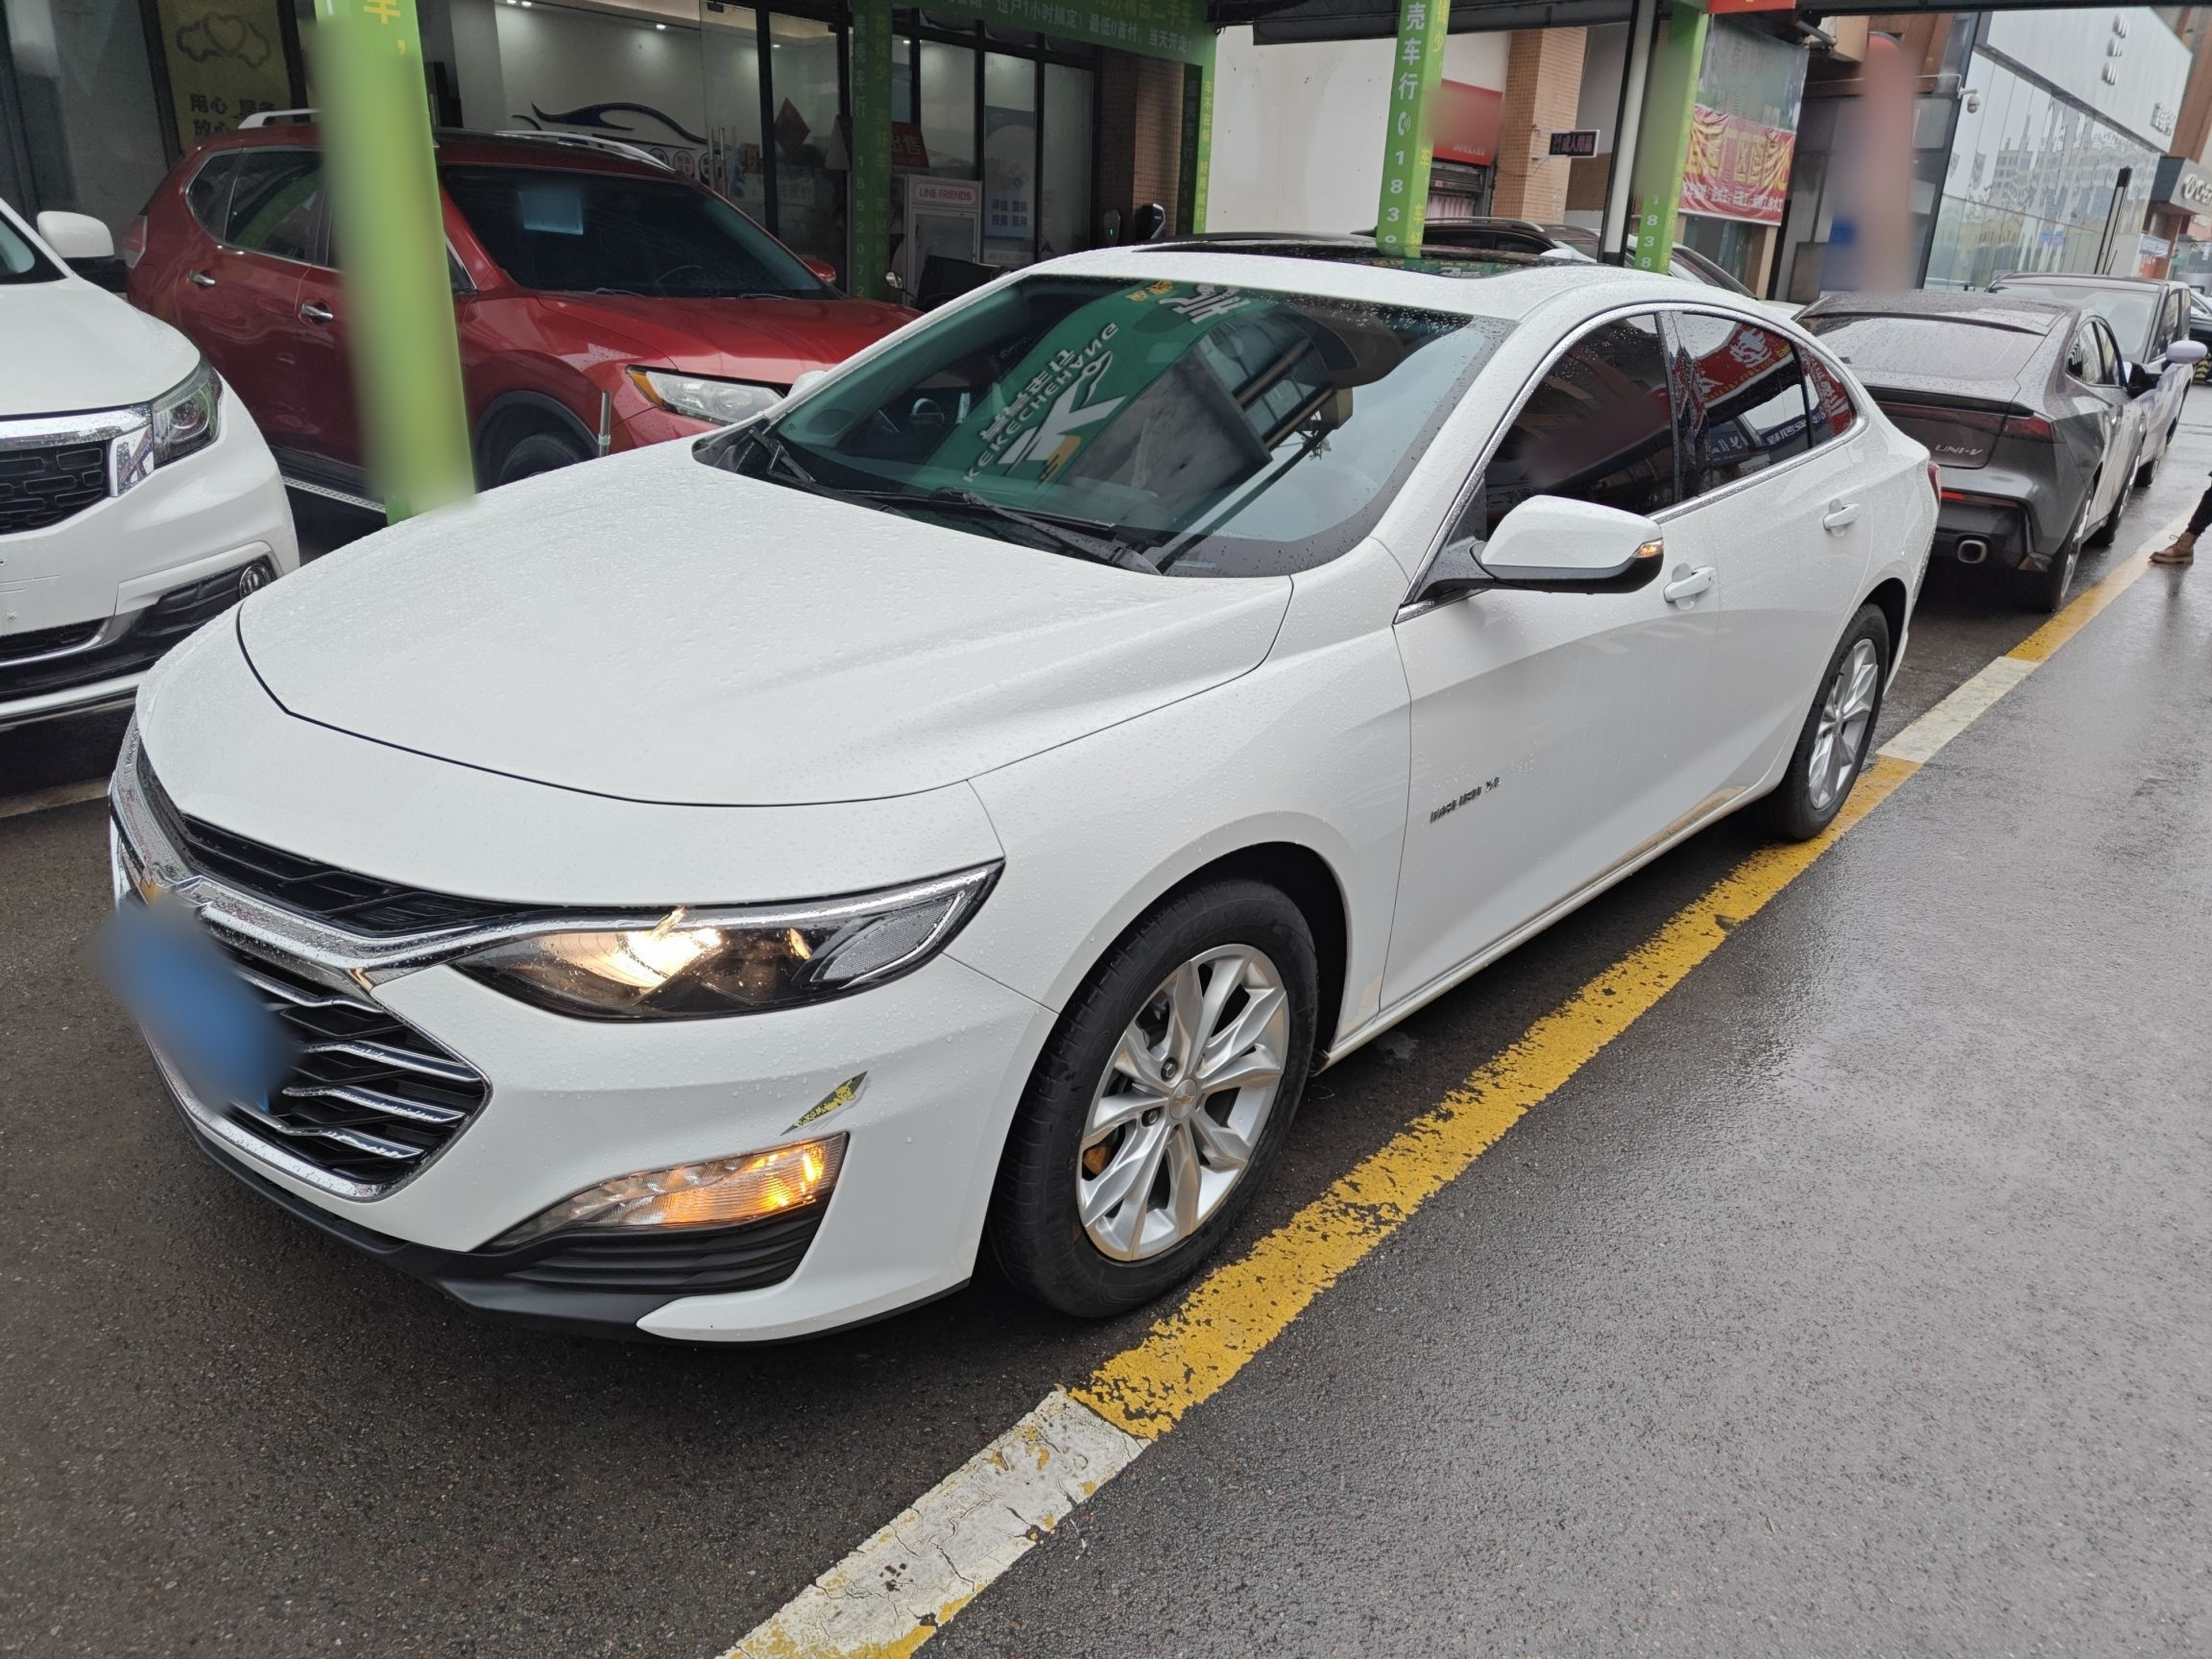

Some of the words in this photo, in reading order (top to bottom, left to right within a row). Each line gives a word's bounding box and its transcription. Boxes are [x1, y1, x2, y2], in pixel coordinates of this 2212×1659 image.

[190, 93, 228, 114] 用心
[919, 187, 937, 199] LINE
[939, 189, 972, 201] FRIENDS
[1936, 444, 1983, 455] UNI-V
